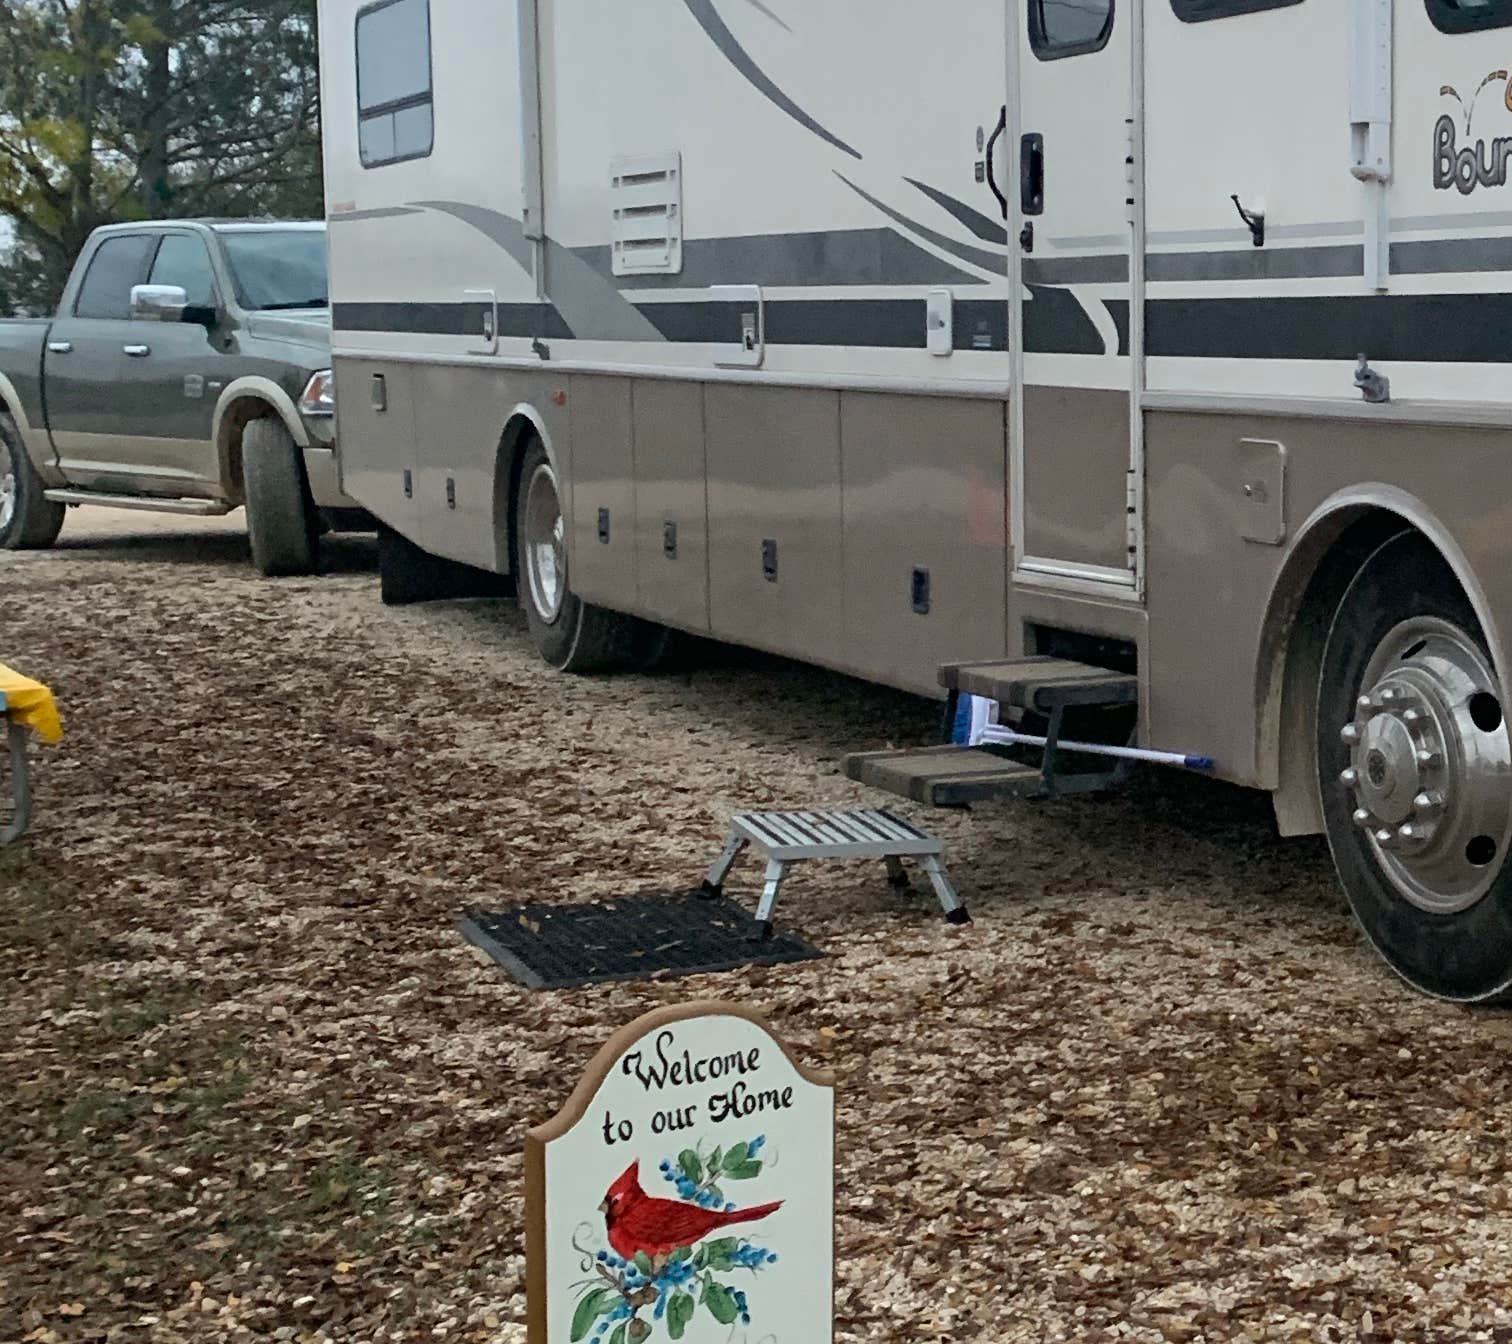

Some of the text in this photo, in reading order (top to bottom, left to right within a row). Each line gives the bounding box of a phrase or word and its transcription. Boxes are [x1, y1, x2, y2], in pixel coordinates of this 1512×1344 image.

[622, 1030, 761, 1092] Welcome
[602, 1080, 794, 1146] to our Home
